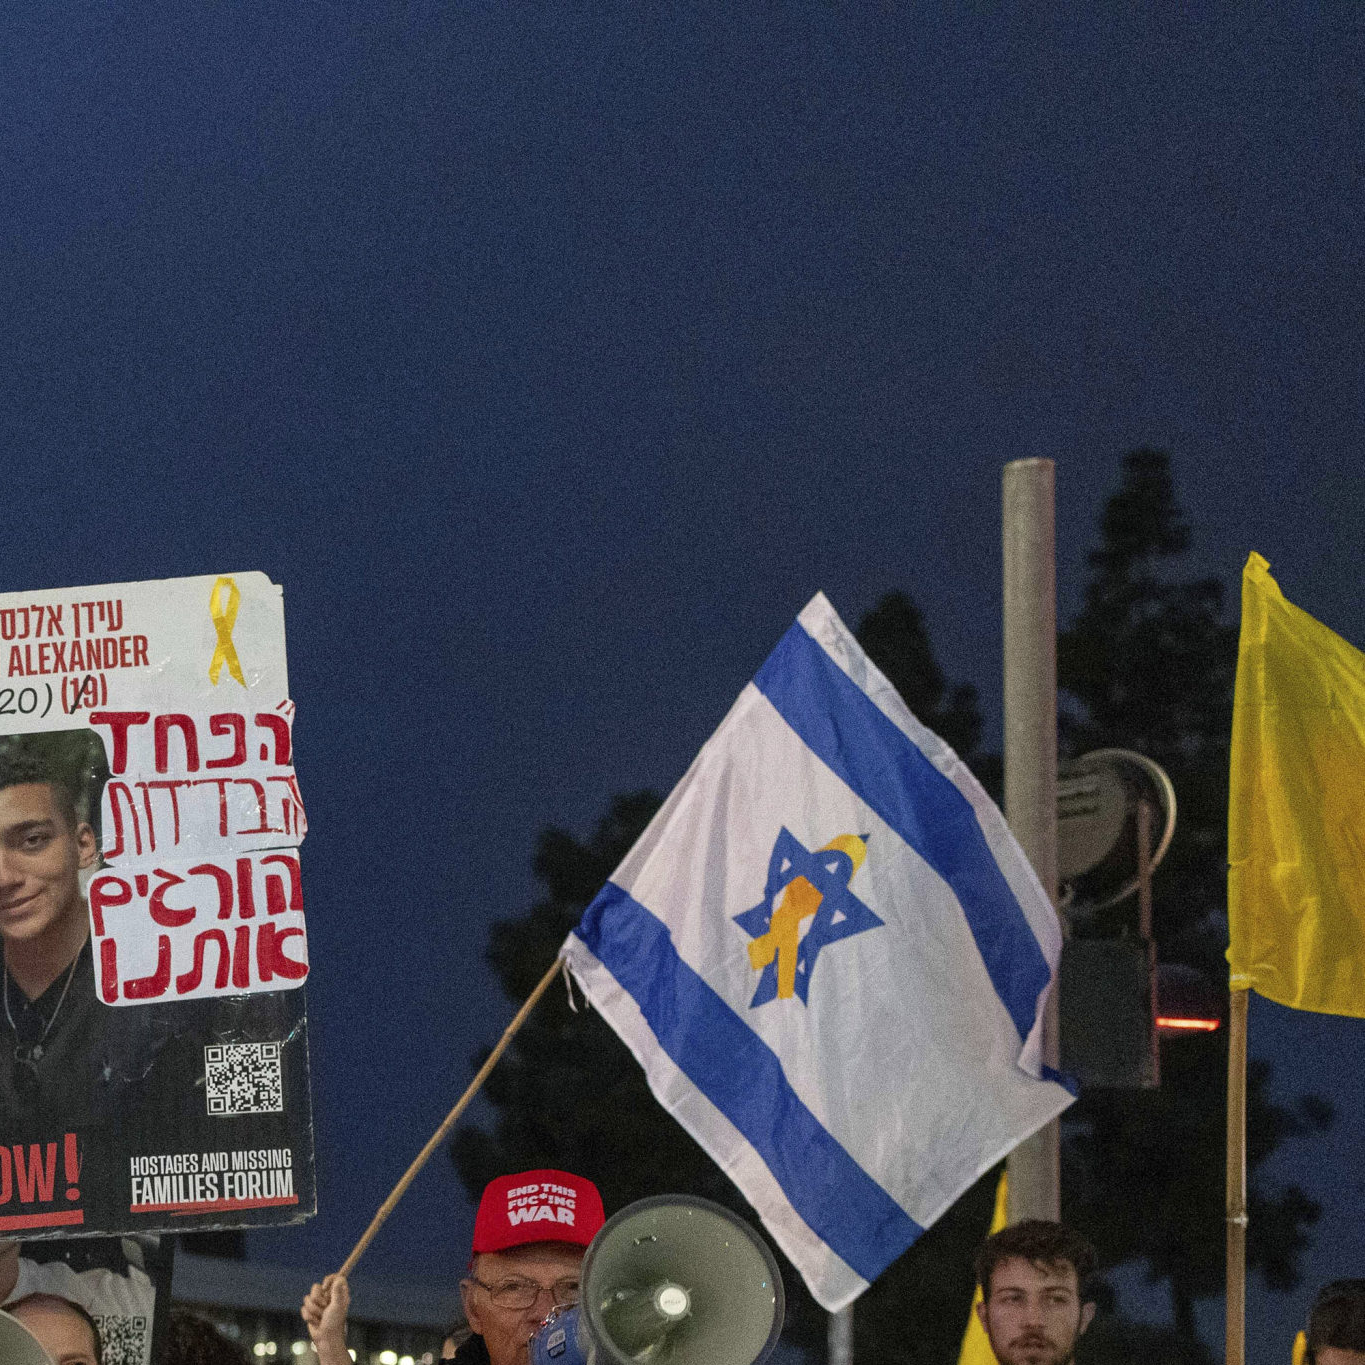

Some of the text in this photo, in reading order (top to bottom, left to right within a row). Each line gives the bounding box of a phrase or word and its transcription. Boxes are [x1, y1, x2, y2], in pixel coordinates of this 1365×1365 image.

[71, 599, 123, 638] עידן
[8, 635, 149, 678] ALEXANDER
[90, 854, 304, 936] הורגים
[100, 922, 310, 1004] אותנו
[130, 1148, 292, 1176] HOSTAGES AND MISSING
[131, 1169, 294, 1206] FAMILIES FORUM
[507, 1183, 576, 1199] END THIS
[507, 1205, 575, 1227] WAR
